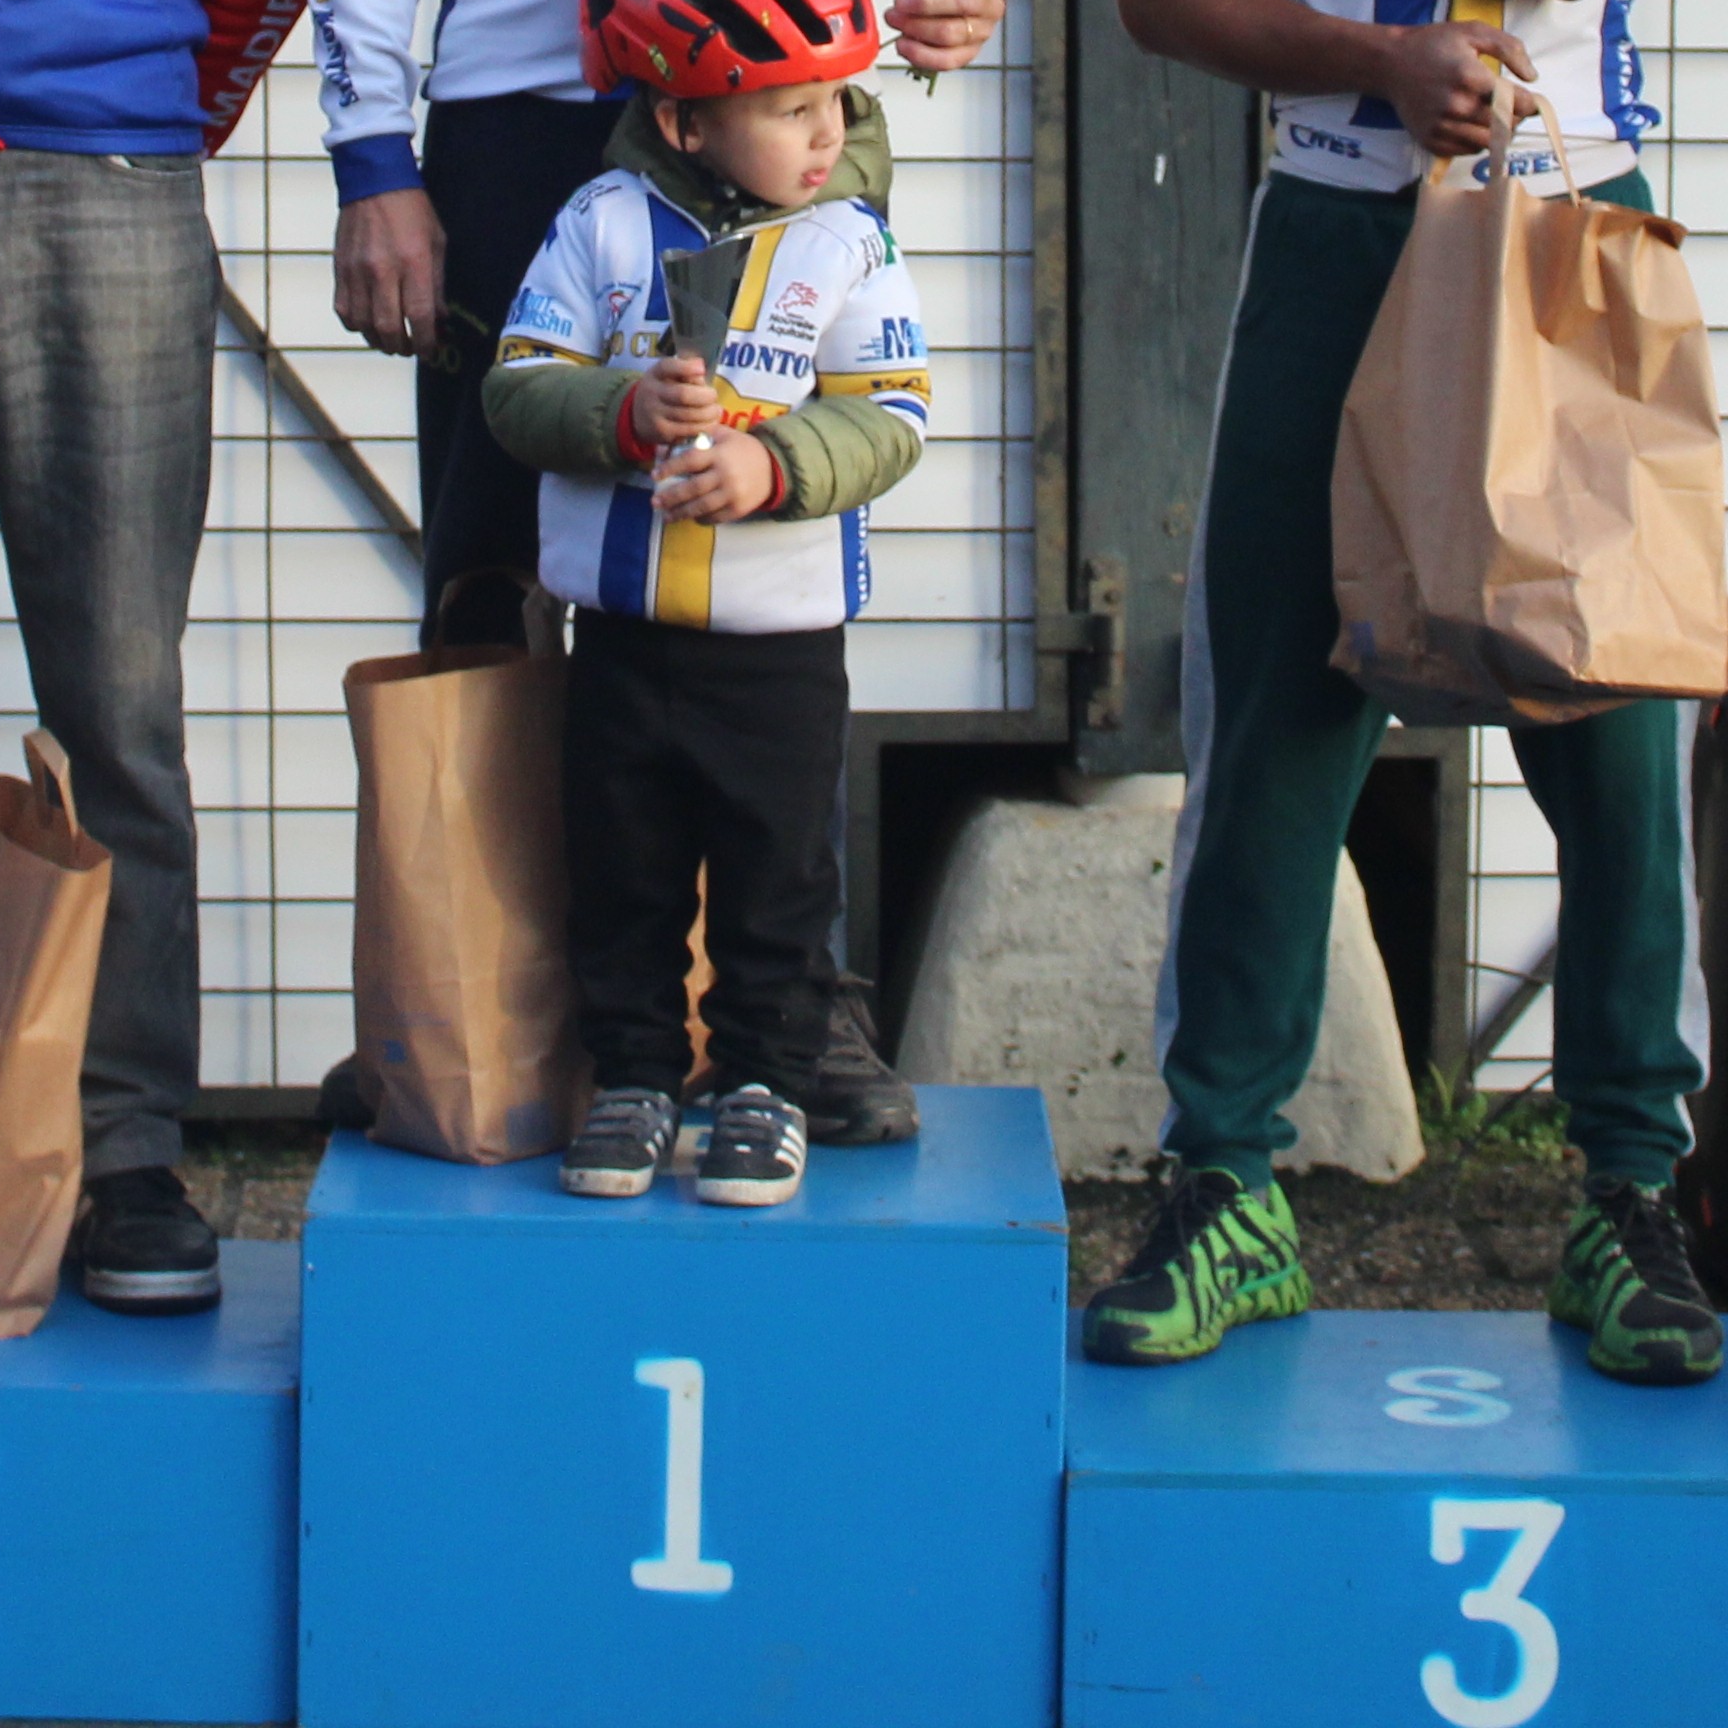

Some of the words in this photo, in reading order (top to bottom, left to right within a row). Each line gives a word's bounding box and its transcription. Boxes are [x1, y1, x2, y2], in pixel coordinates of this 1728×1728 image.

[720, 340, 812, 380] MONTO
[631, 1357, 734, 1595] 1
[1419, 1497, 1566, 1728] 3
